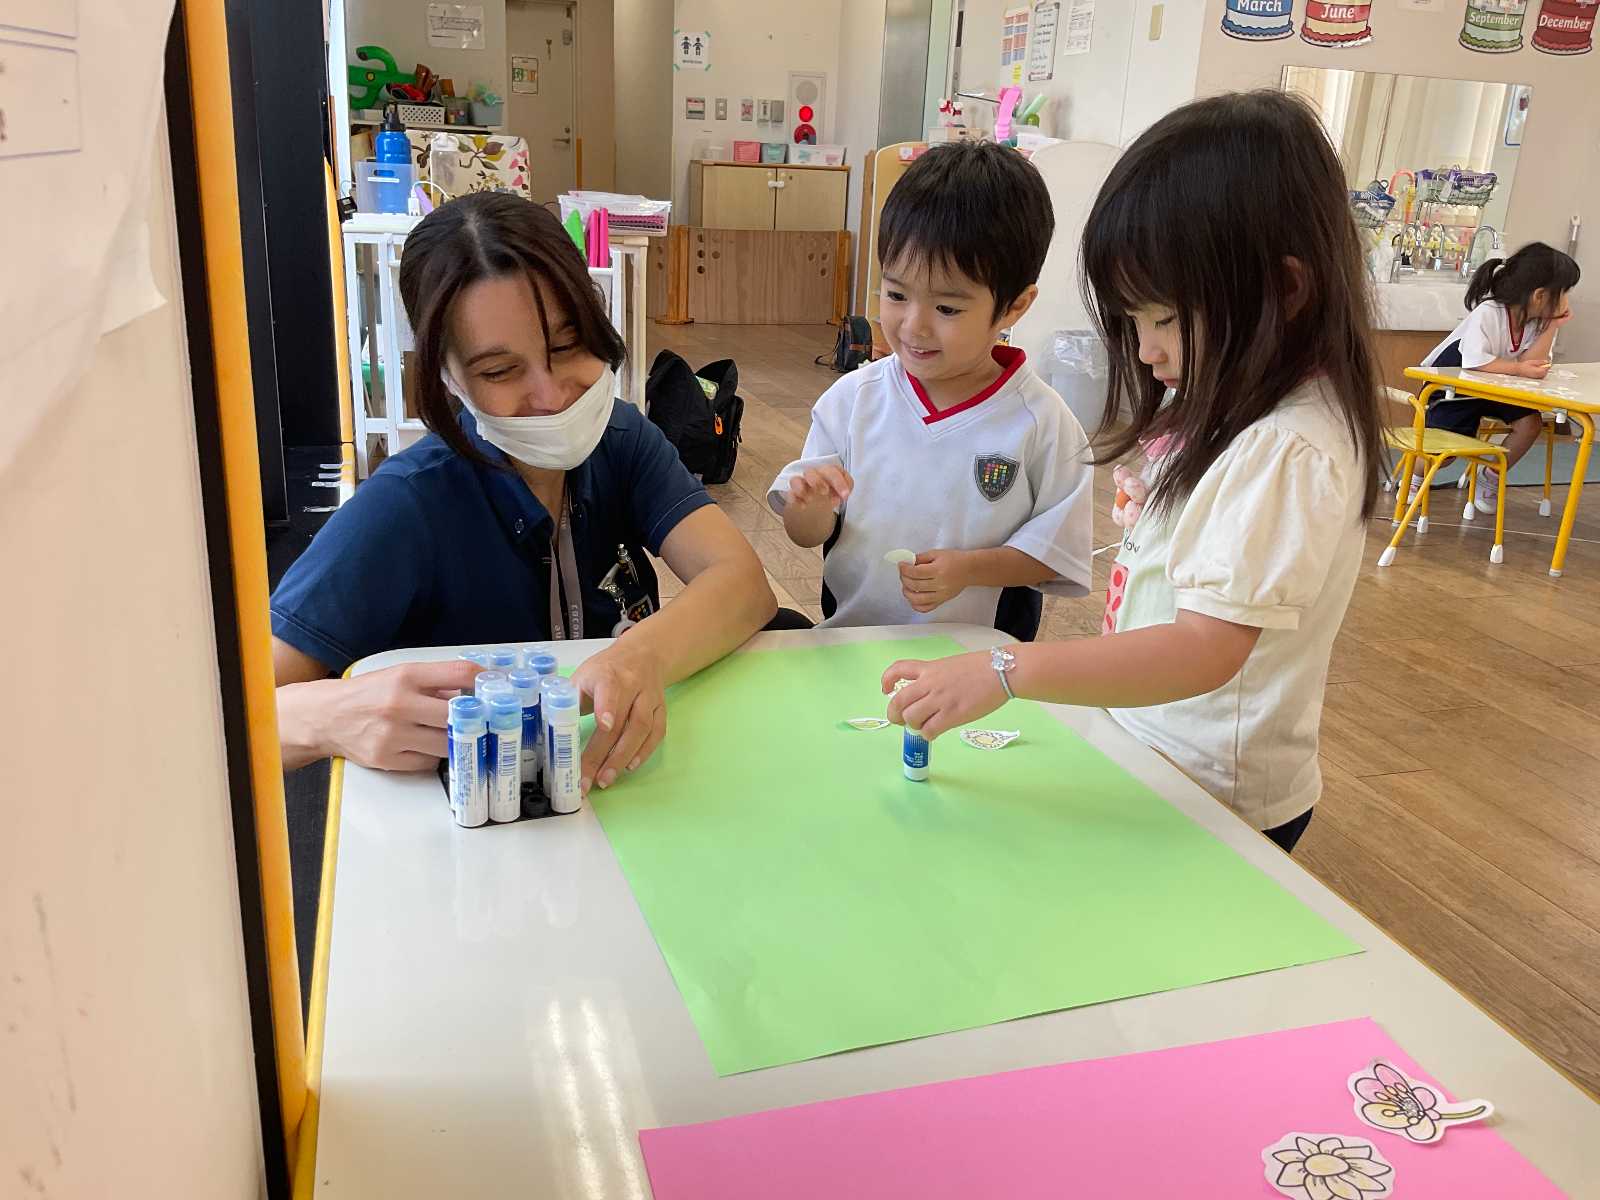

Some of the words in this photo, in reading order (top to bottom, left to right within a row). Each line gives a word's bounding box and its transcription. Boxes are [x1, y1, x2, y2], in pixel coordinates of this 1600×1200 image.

[1236, 0, 1283, 12] March
[1320, 4, 1355, 18] June
[1469, 11, 1520, 25] September
[1539, 14, 1591, 30] December
